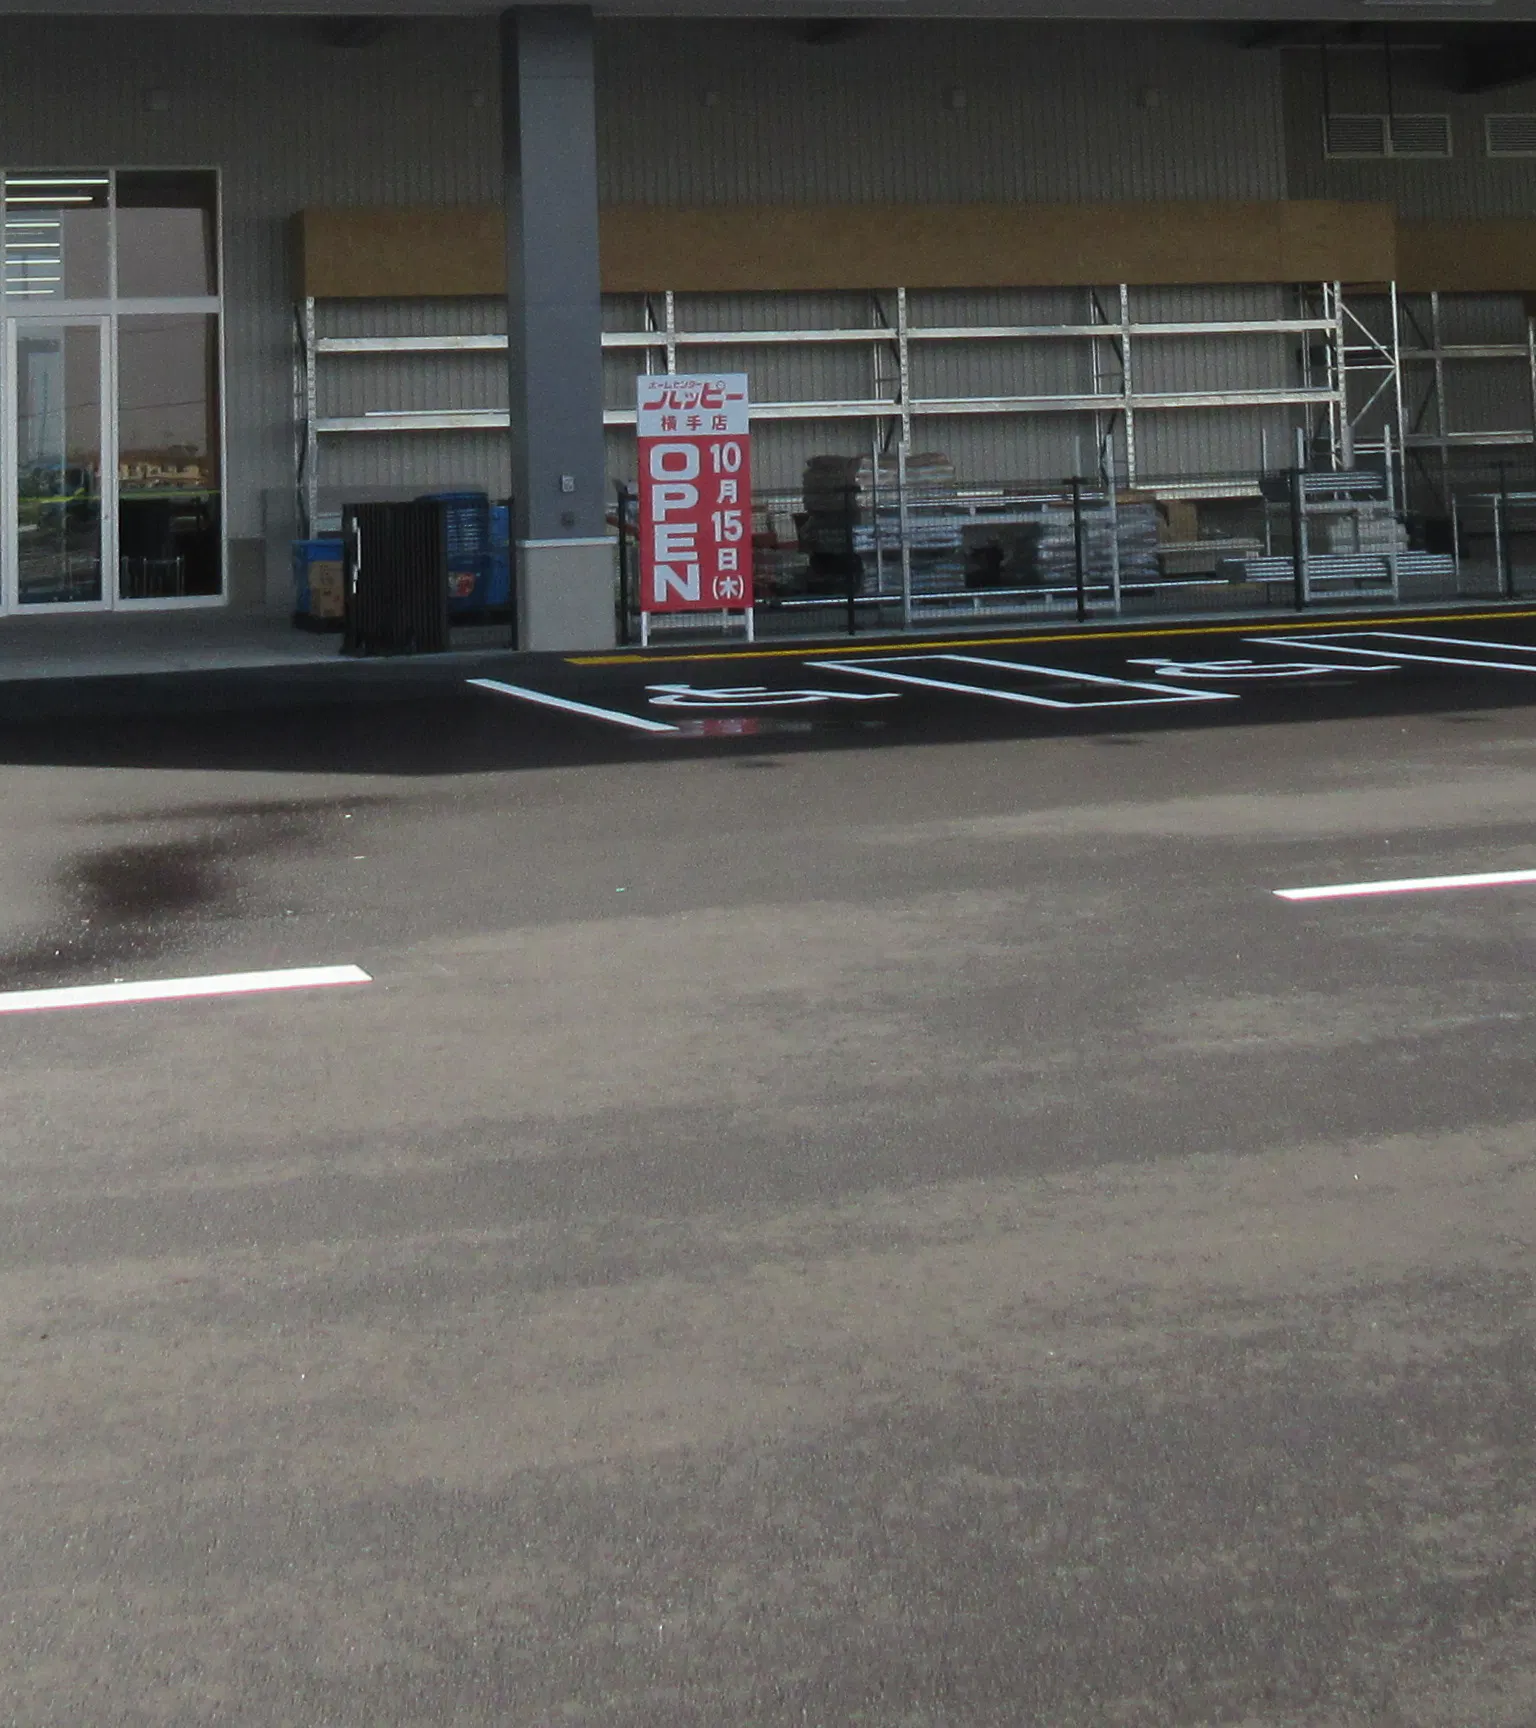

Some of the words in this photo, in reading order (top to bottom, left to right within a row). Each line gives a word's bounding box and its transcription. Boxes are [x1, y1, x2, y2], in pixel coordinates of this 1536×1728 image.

[642, 380, 744, 410] ハッピー
[648, 380, 701, 390] ホームセンター
[660, 414, 728, 432] 横手店
[649, 442, 701, 603] OPEN
